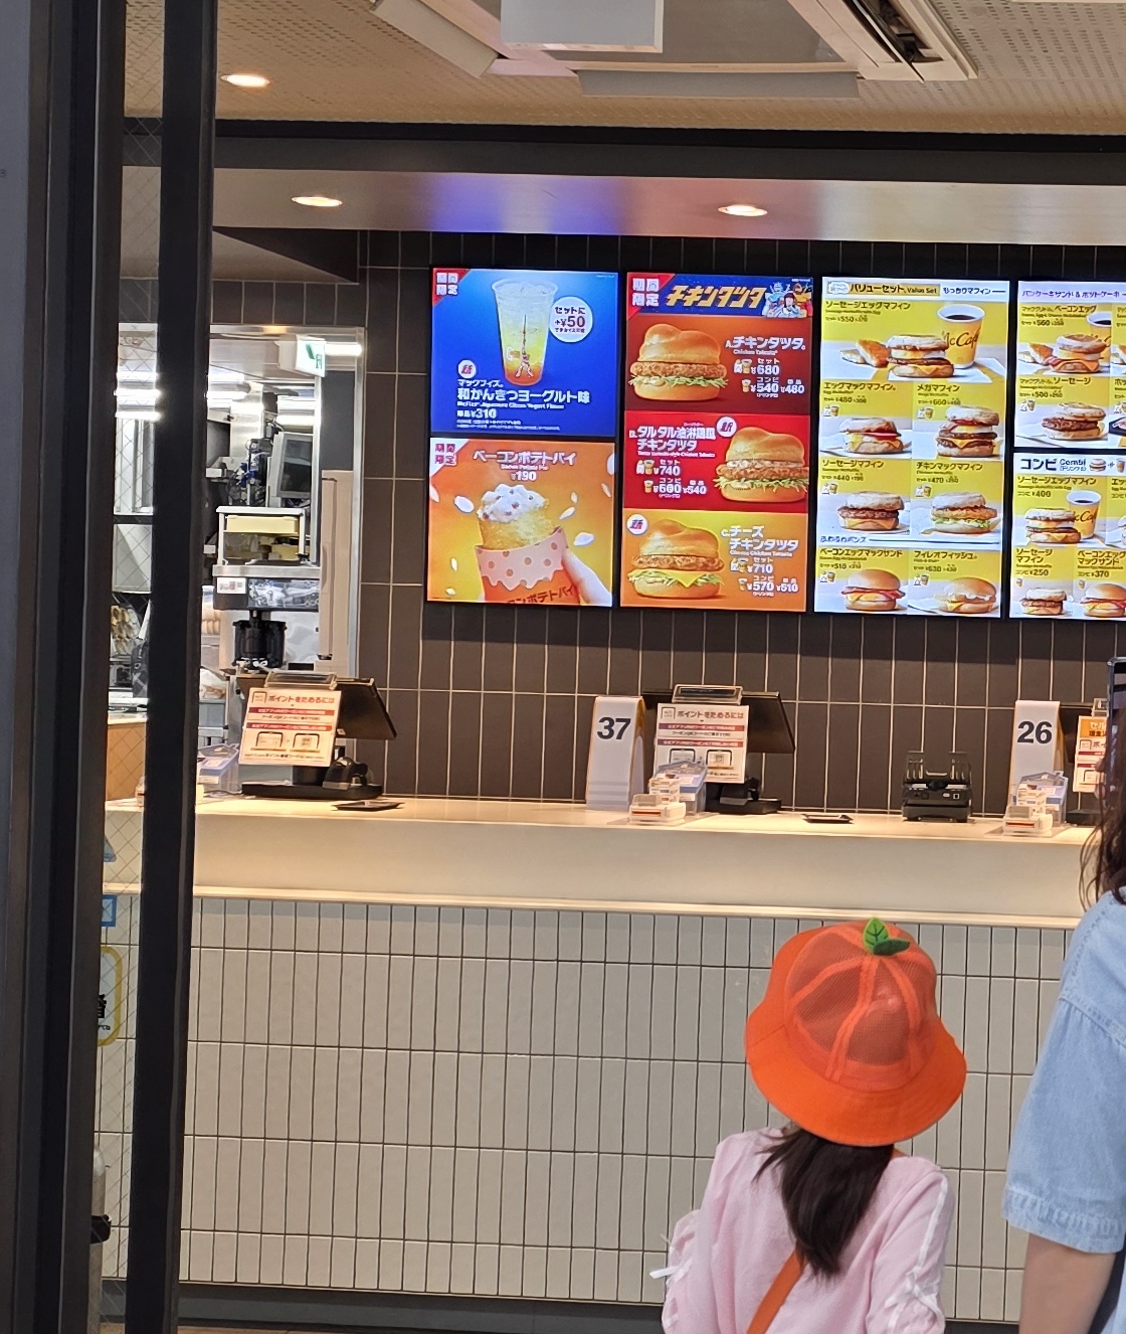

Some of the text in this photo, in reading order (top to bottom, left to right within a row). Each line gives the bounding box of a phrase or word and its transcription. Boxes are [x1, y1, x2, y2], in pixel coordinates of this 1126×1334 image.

[665, 285, 767, 308] チキンタツタ
[826, 301, 911, 310] ソーセージエッグマフィン
[1055, 305, 1097, 313] ベーコンエッグ
[1053, 377, 1091, 385] ソーセージ
[917, 384, 960, 392] メガマフィン
[637, 439, 697, 451] チキンタツタ
[473, 450, 577, 465] ベーコンポテトパイ
[822, 460, 884, 468] ソーセージマフィン
[916, 462, 983, 471] チキンマックマフィン
[1020, 459, 1057, 471] コンビ
[653, 466, 680, 475] ¥740
[1017, 476, 1097, 485] ソーセージエッグマフィン
[729, 539, 799, 551] チキンタツタ
[820, 548, 903, 557] ベーコンエッグマックサンド
[677, 710, 744, 719] ポイントをためるには
[597, 717, 631, 740] 37
[1017, 721, 1052, 744] 26
